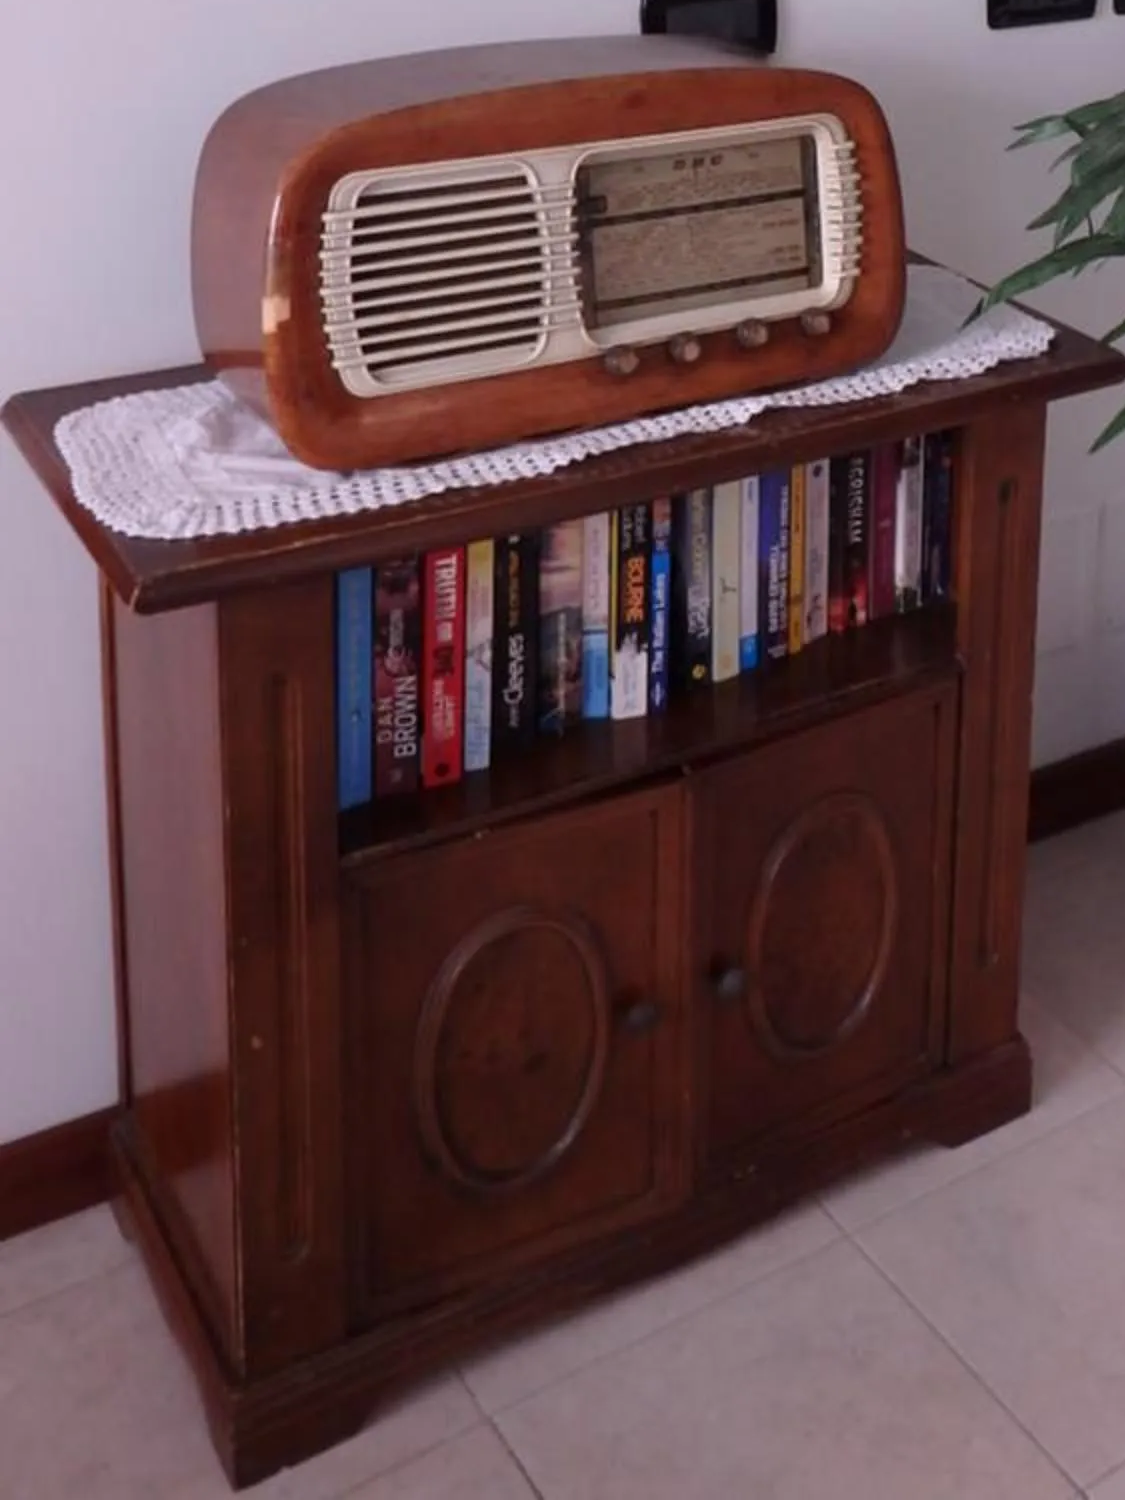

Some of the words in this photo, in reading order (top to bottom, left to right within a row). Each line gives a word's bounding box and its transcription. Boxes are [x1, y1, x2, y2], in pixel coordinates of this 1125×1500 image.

[435, 553, 457, 620] TRUTH
[656, 573, 667, 609] Lakes
[503, 634, 524, 704] Cleeves
[652, 651, 664, 672] The
[376, 697, 392, 744] DAN
[393, 675, 417, 758] BROWN
